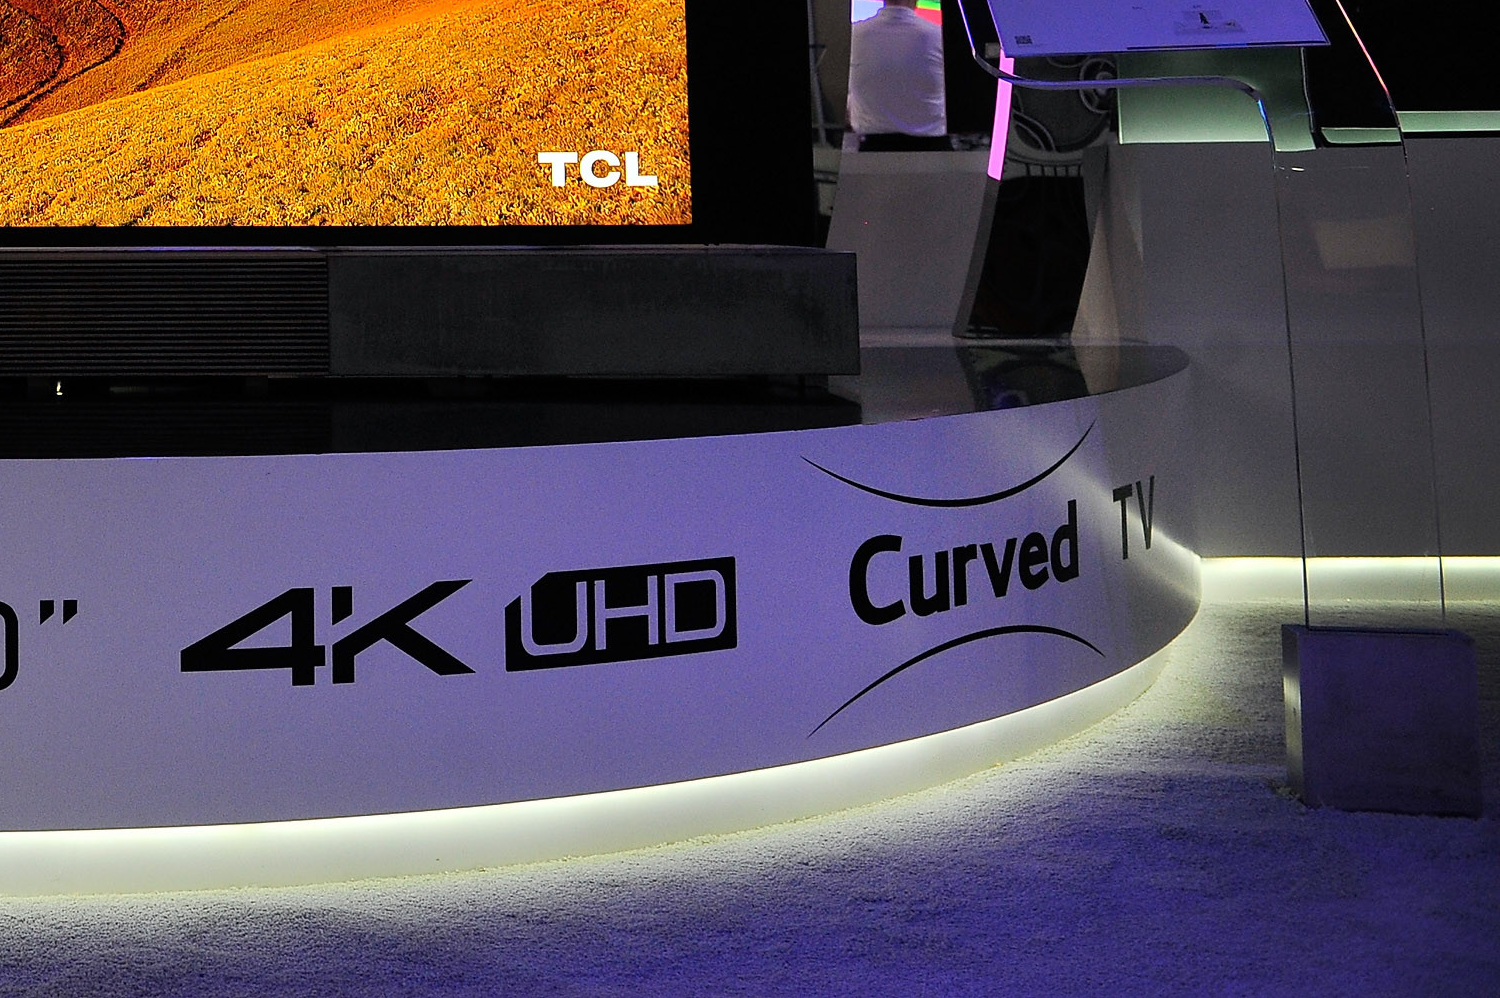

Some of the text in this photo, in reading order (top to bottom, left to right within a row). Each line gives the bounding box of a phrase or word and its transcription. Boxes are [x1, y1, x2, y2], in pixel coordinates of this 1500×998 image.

[537, 149, 659, 188] TCL
[849, 475, 1155, 626] Curved TV
[180, 568, 728, 687] 4K UHD
